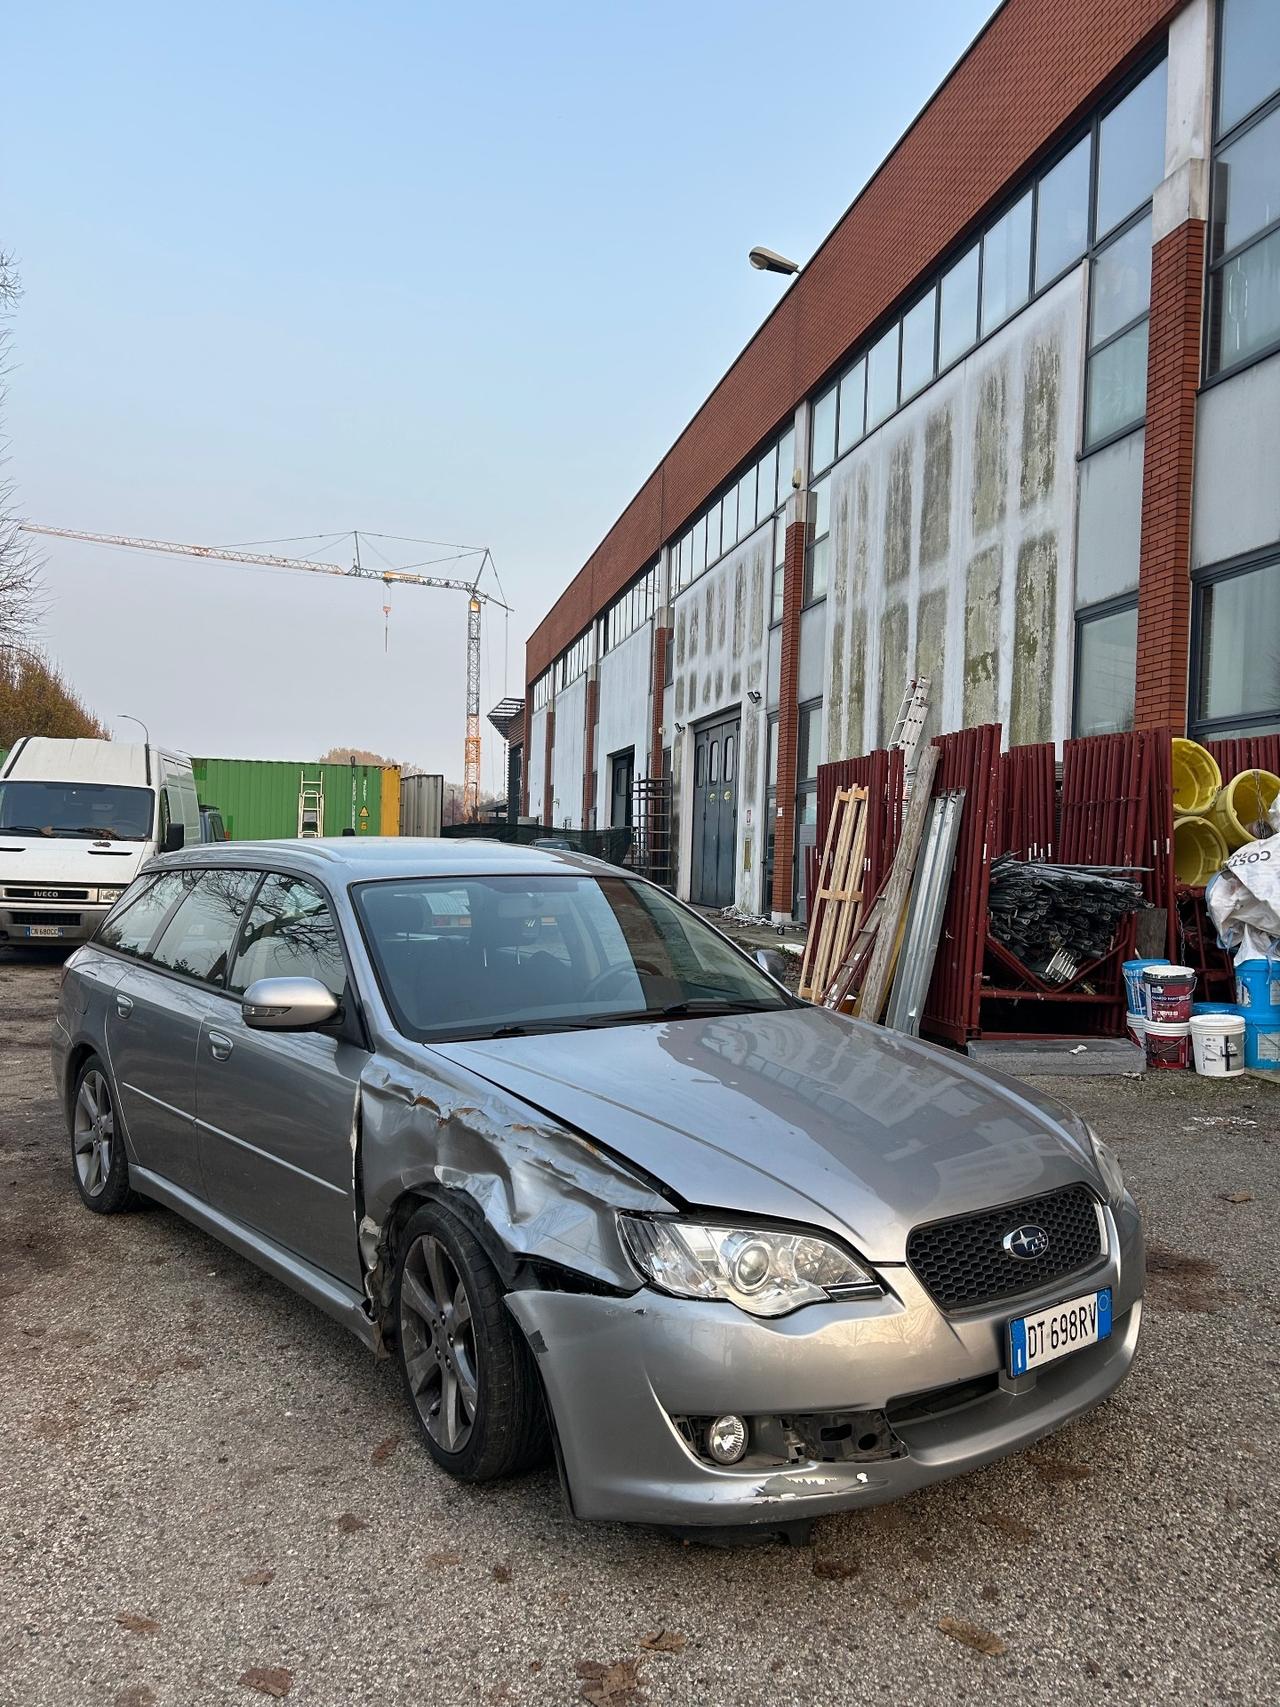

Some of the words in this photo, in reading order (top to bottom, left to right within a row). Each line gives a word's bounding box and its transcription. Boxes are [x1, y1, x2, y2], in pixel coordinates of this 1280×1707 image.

[1229, 850, 1271, 867] COST
[1027, 1320, 1045, 1359] DT
[1050, 1301, 1097, 1350] 698RV
